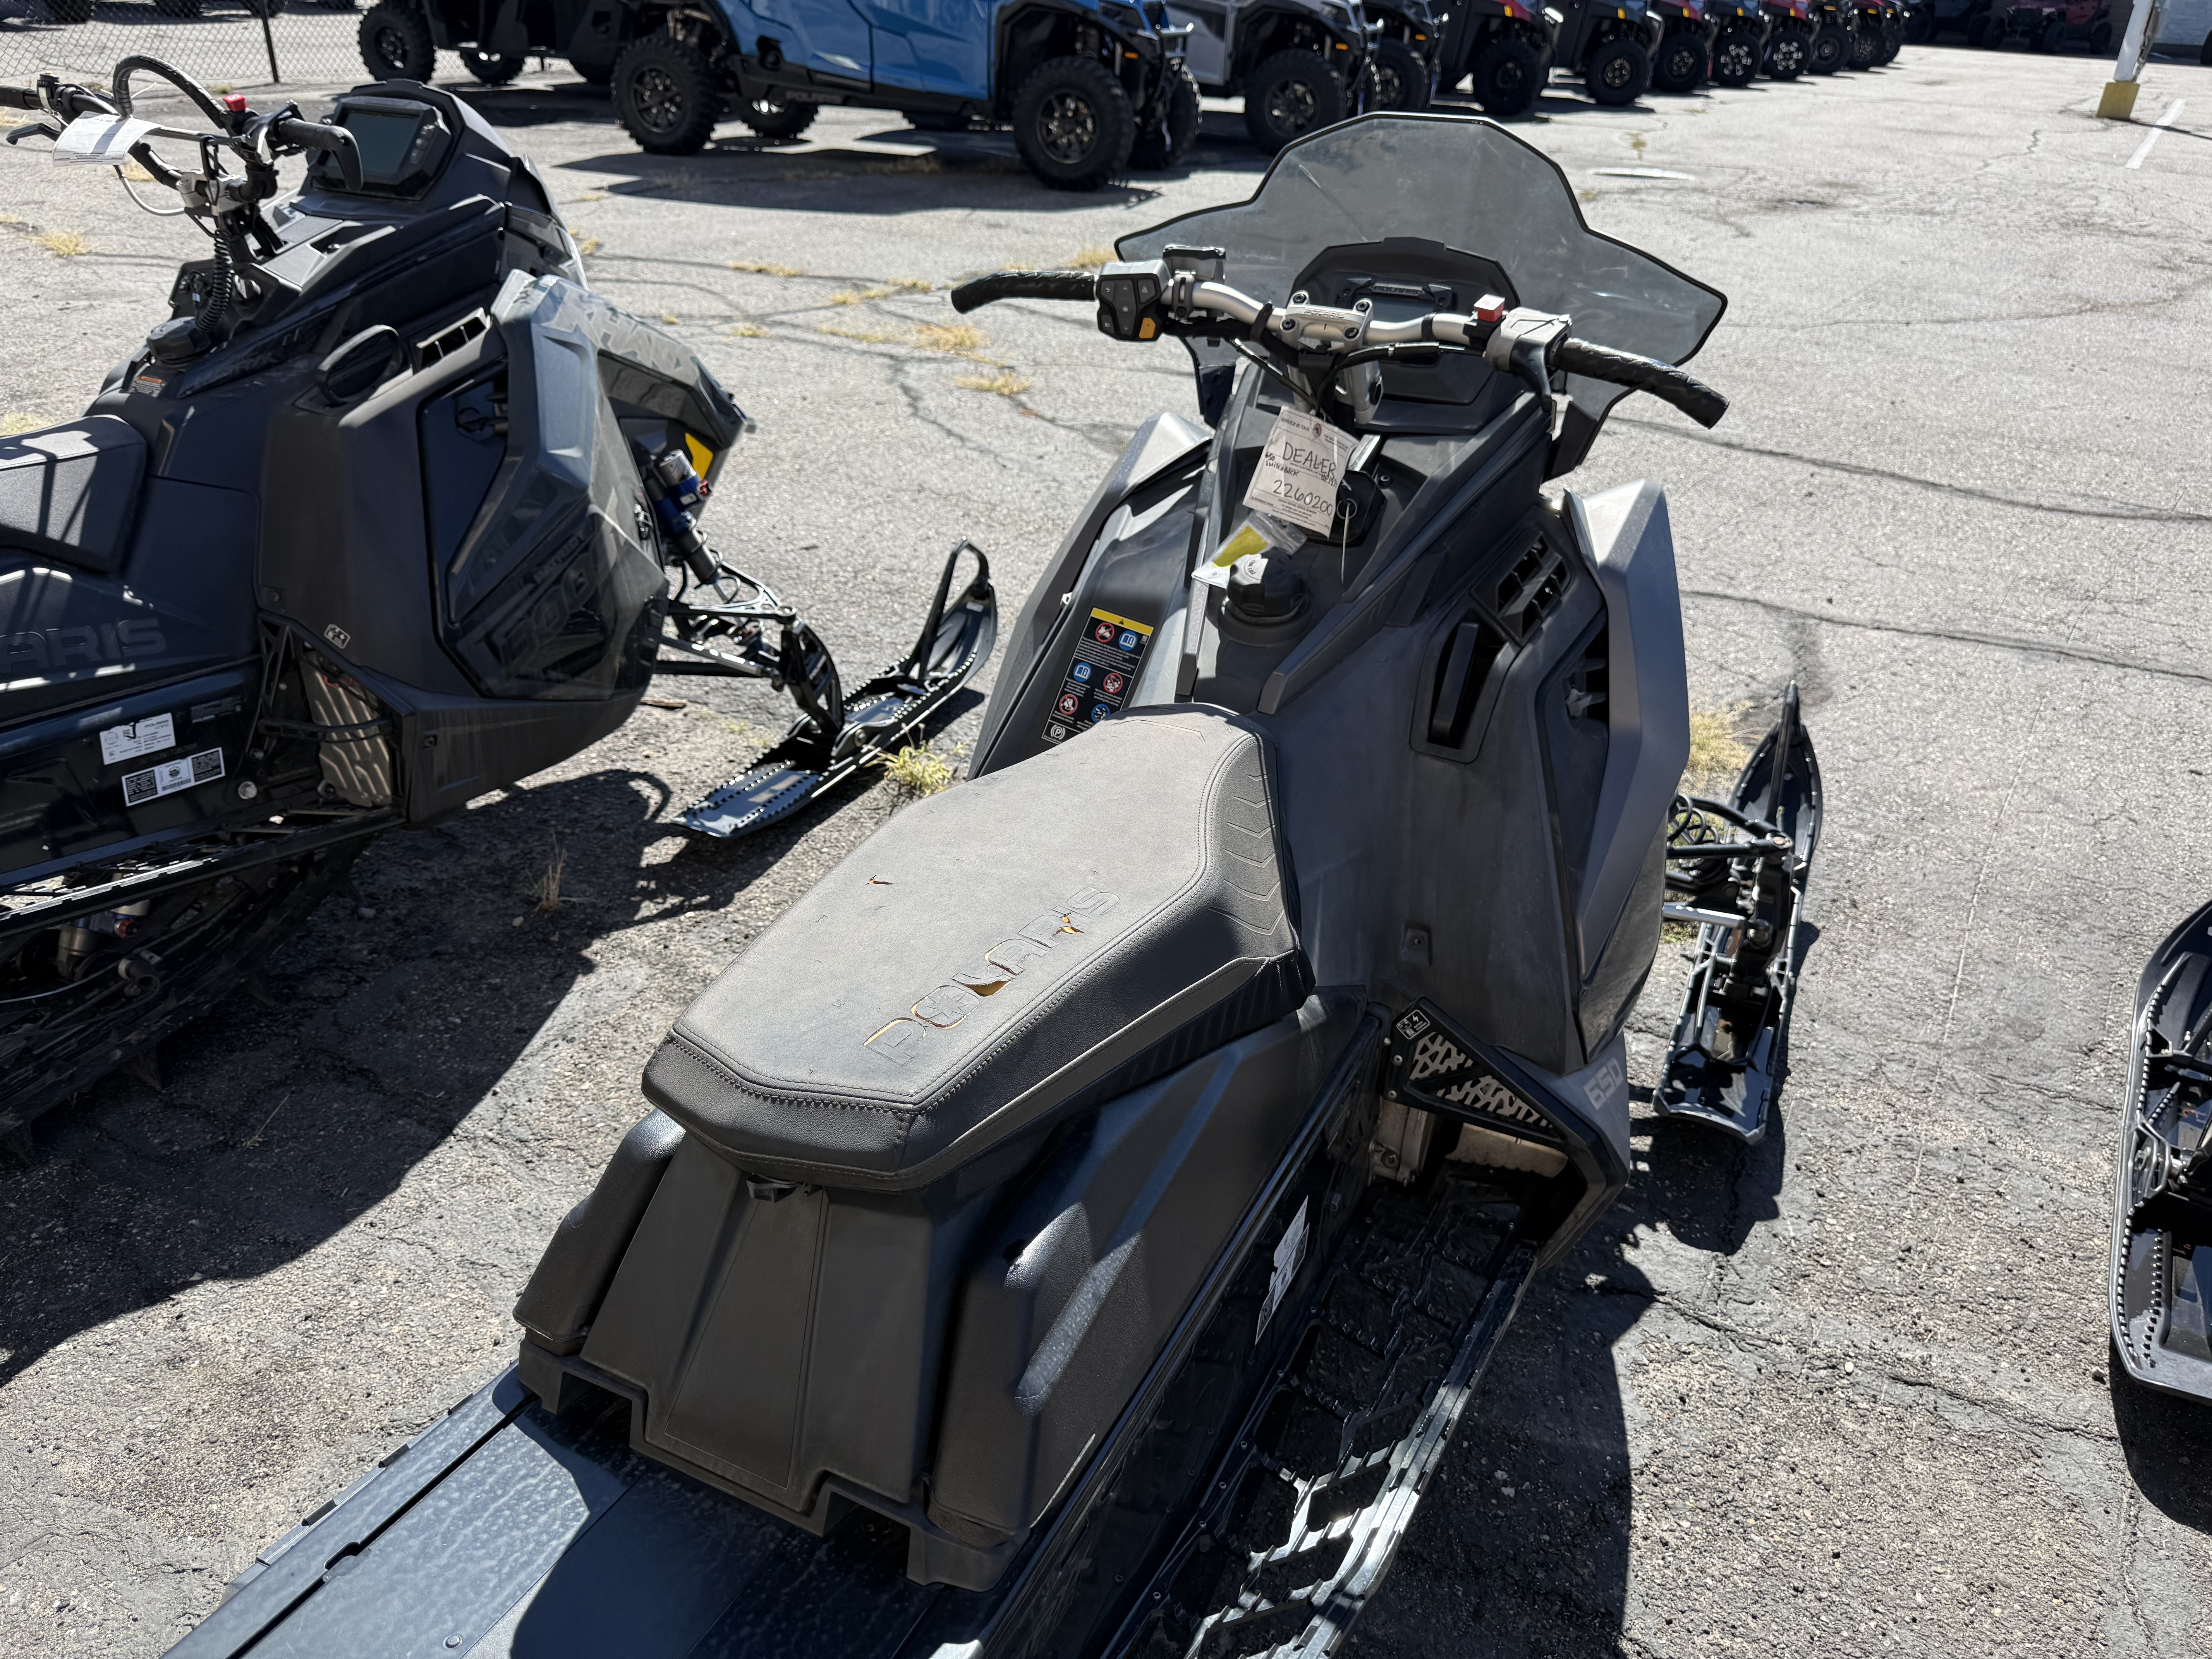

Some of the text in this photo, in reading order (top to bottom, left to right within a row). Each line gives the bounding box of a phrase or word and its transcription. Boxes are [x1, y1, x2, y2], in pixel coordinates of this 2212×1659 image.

[785, 91, 843, 104] POLARIS
[1373, 285, 1420, 295] POLARIS
[1304, 308, 1346, 318] POLARIS
[1283, 442, 1336, 477] DEALER
[1273, 479, 1333, 516] 2260200
[863, 886, 1120, 1065] POLARIS
[1583, 1057, 1624, 1111] 650
